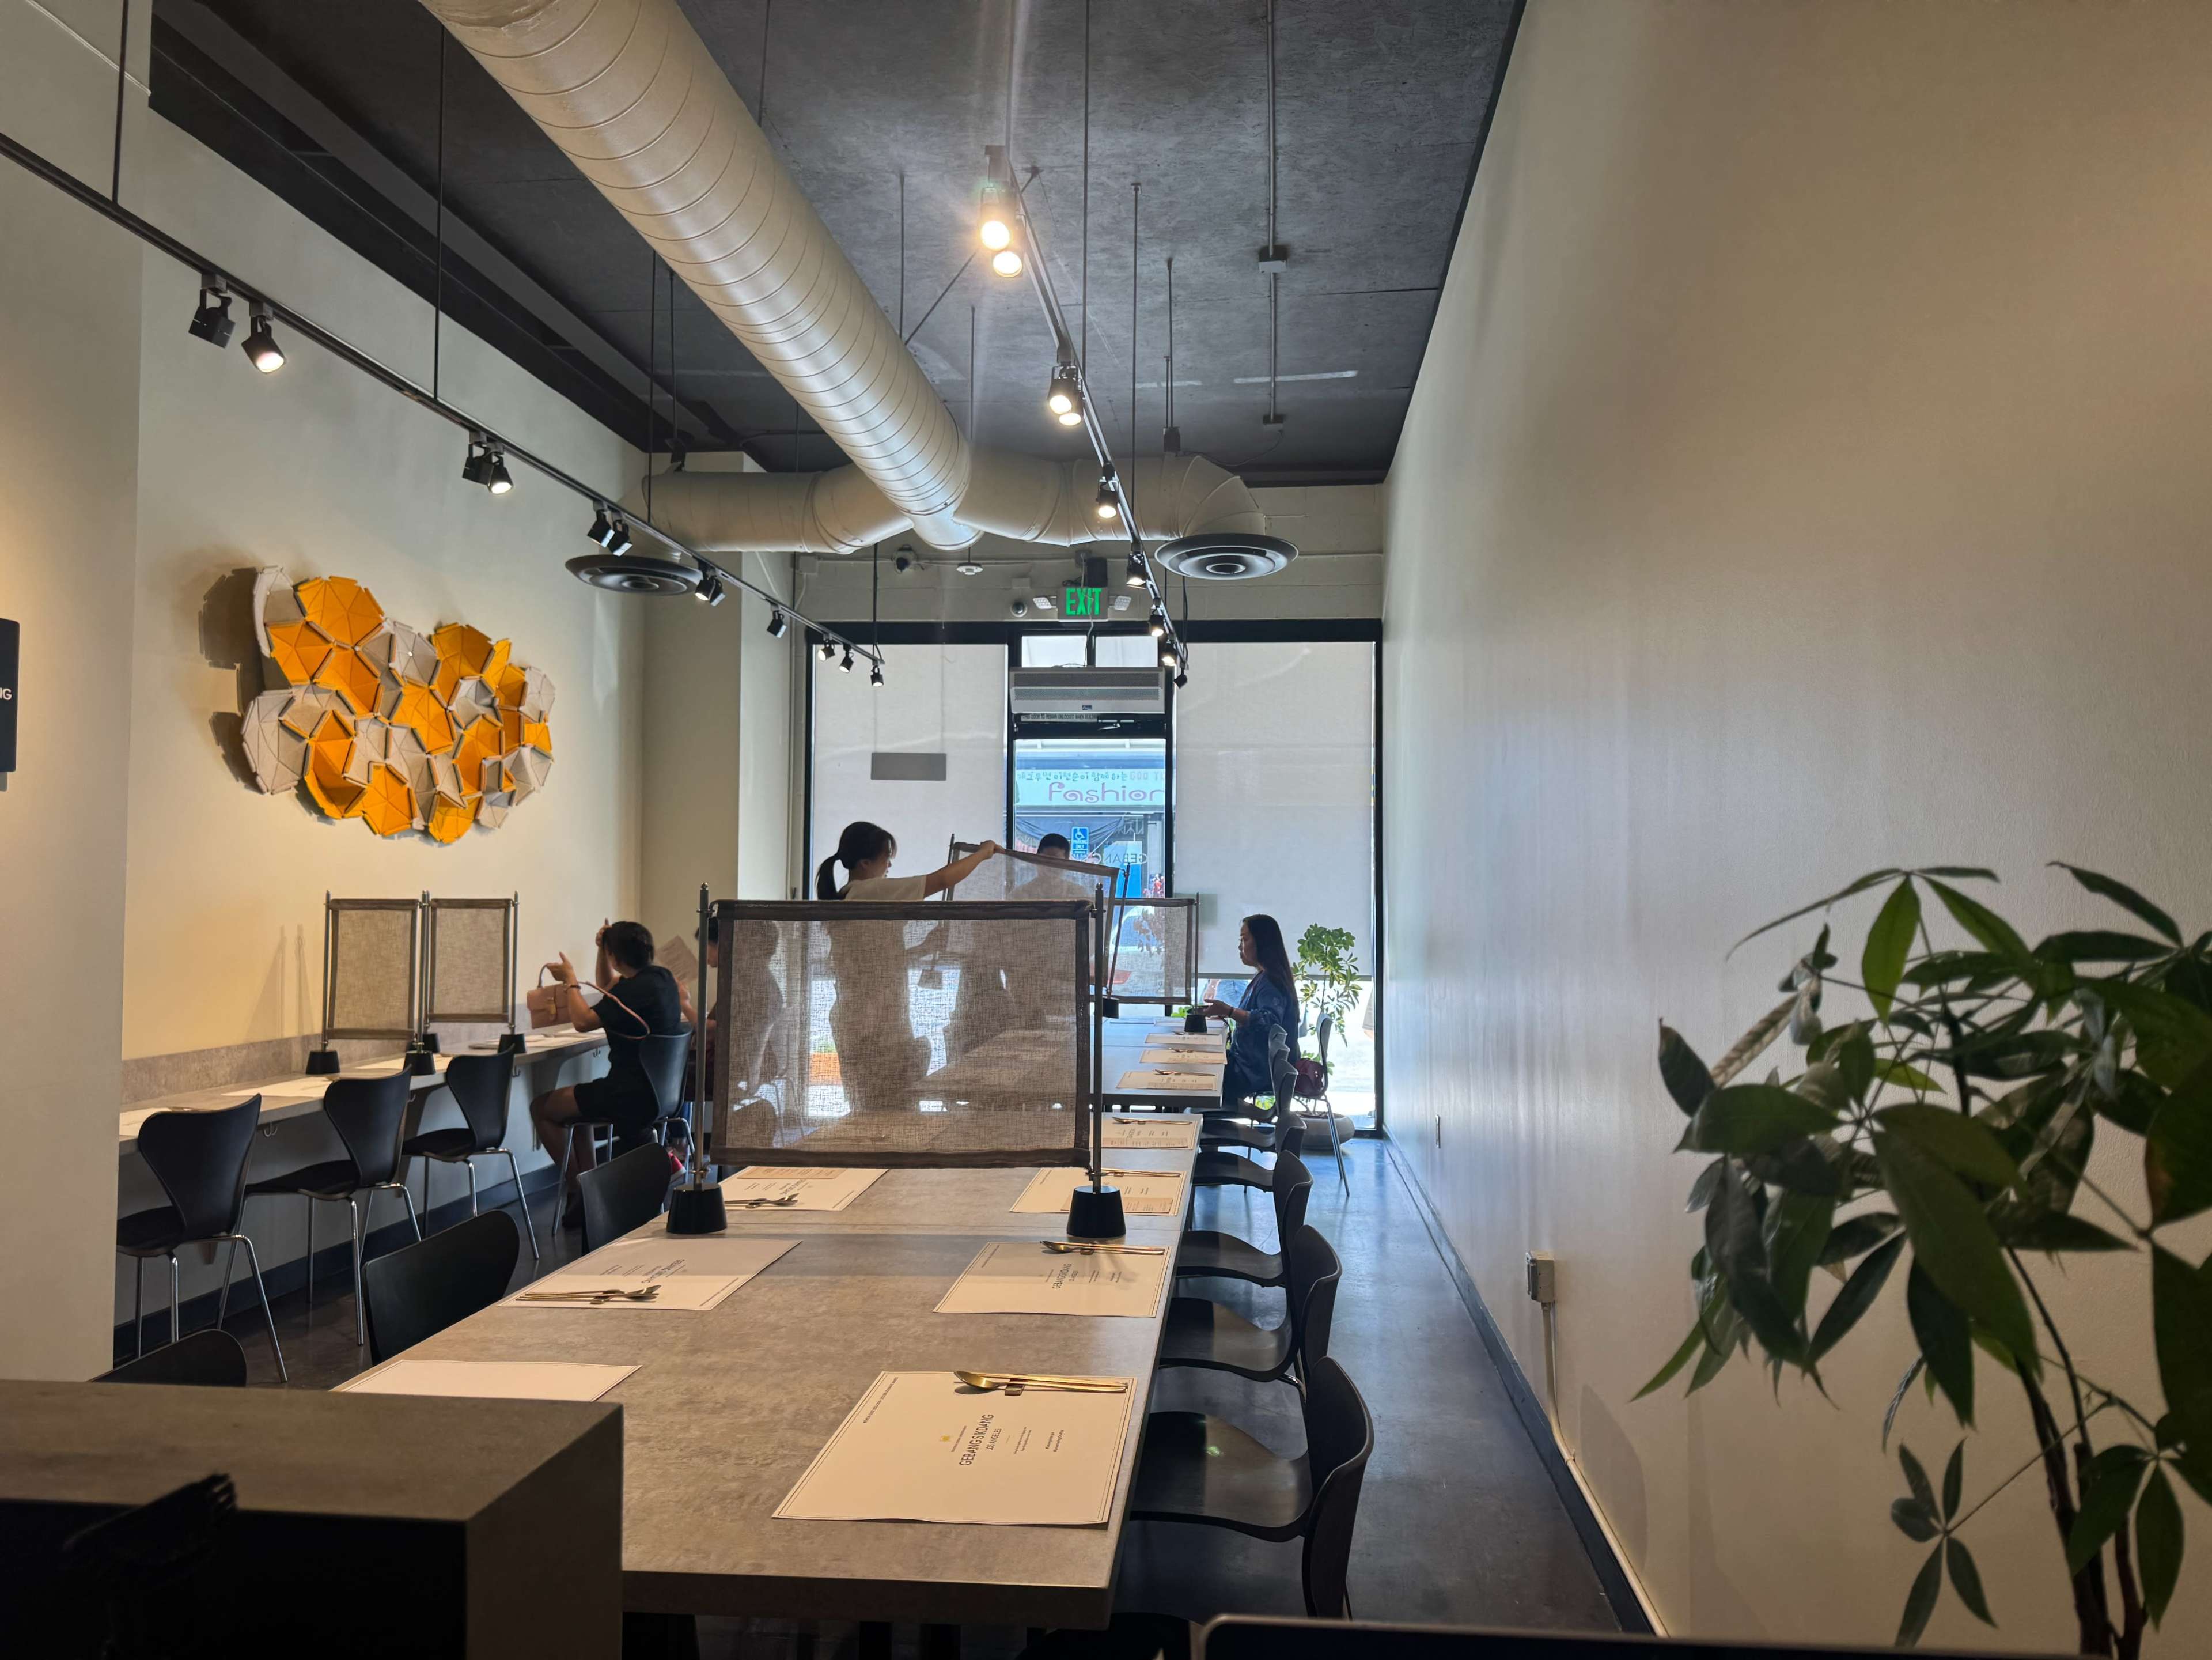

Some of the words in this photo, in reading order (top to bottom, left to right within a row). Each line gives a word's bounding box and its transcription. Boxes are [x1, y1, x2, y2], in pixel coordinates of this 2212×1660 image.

[1066, 588, 1101, 615] EXIT
[959, 1440, 982, 1466] GEBANG
[972, 1414, 994, 1439] SIKDANG
[989, 1428, 1002, 1445] ANGELES
